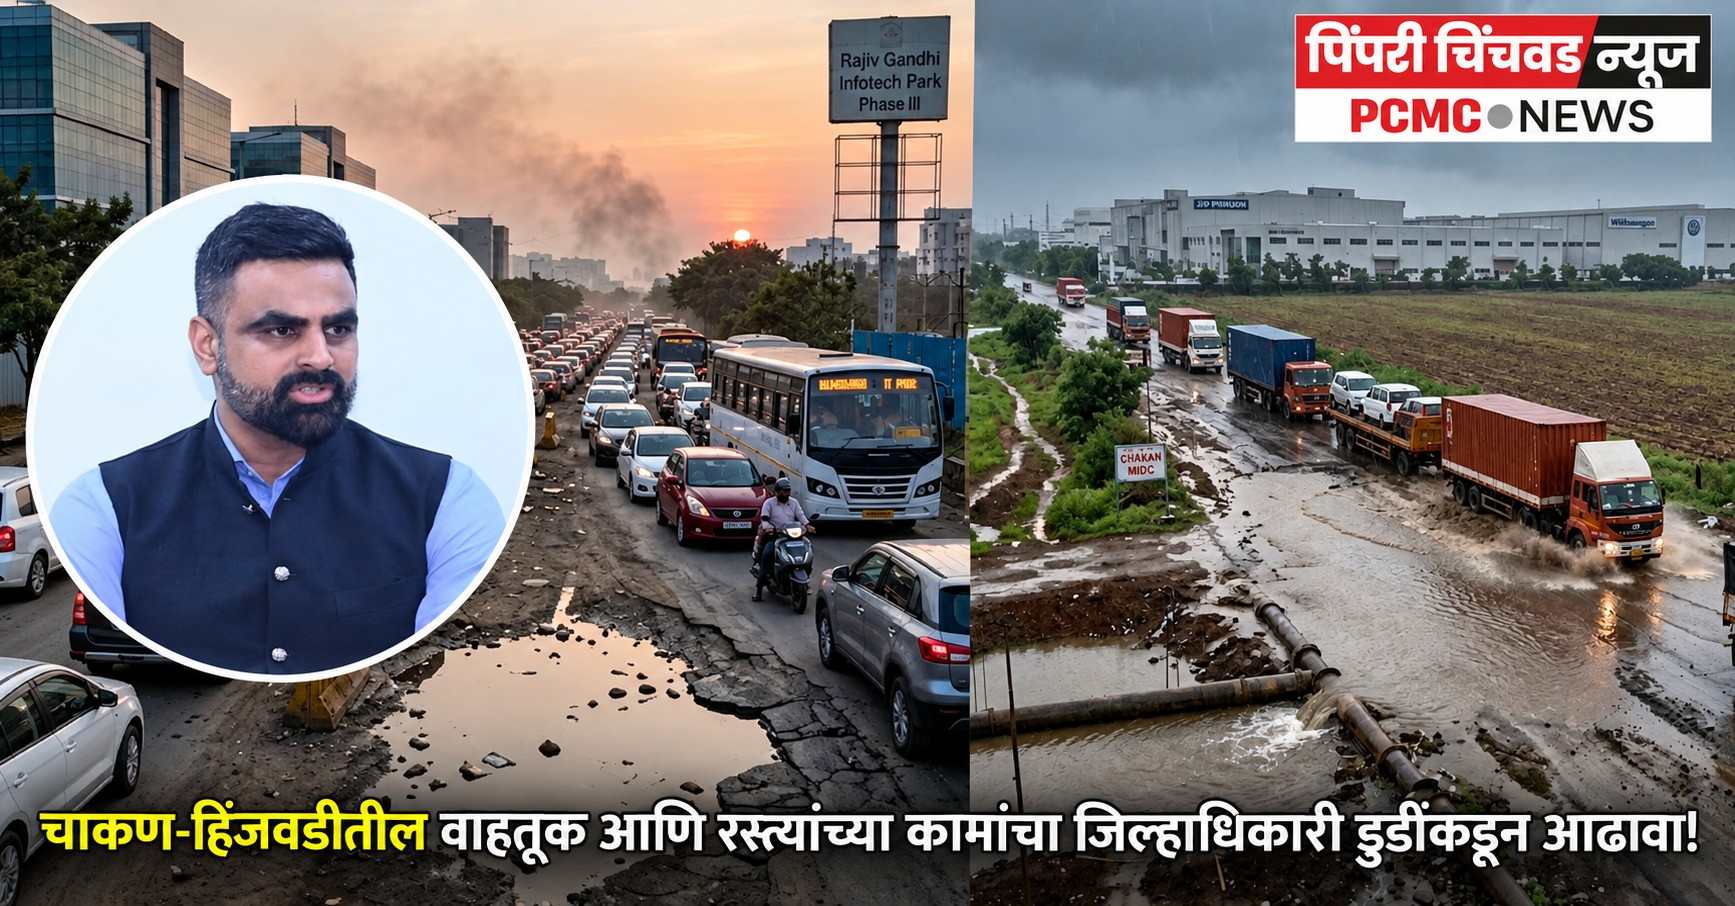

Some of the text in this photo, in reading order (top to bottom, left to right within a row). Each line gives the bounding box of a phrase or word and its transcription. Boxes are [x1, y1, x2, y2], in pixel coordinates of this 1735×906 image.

[840, 50, 941, 71] Rajiv Gandhi
[839, 72, 942, 90] Infotech Park
[859, 96, 921, 112] Phase III
[1120, 452, 1162, 464] CHAKAN
[1127, 464, 1155, 476] MIDC
